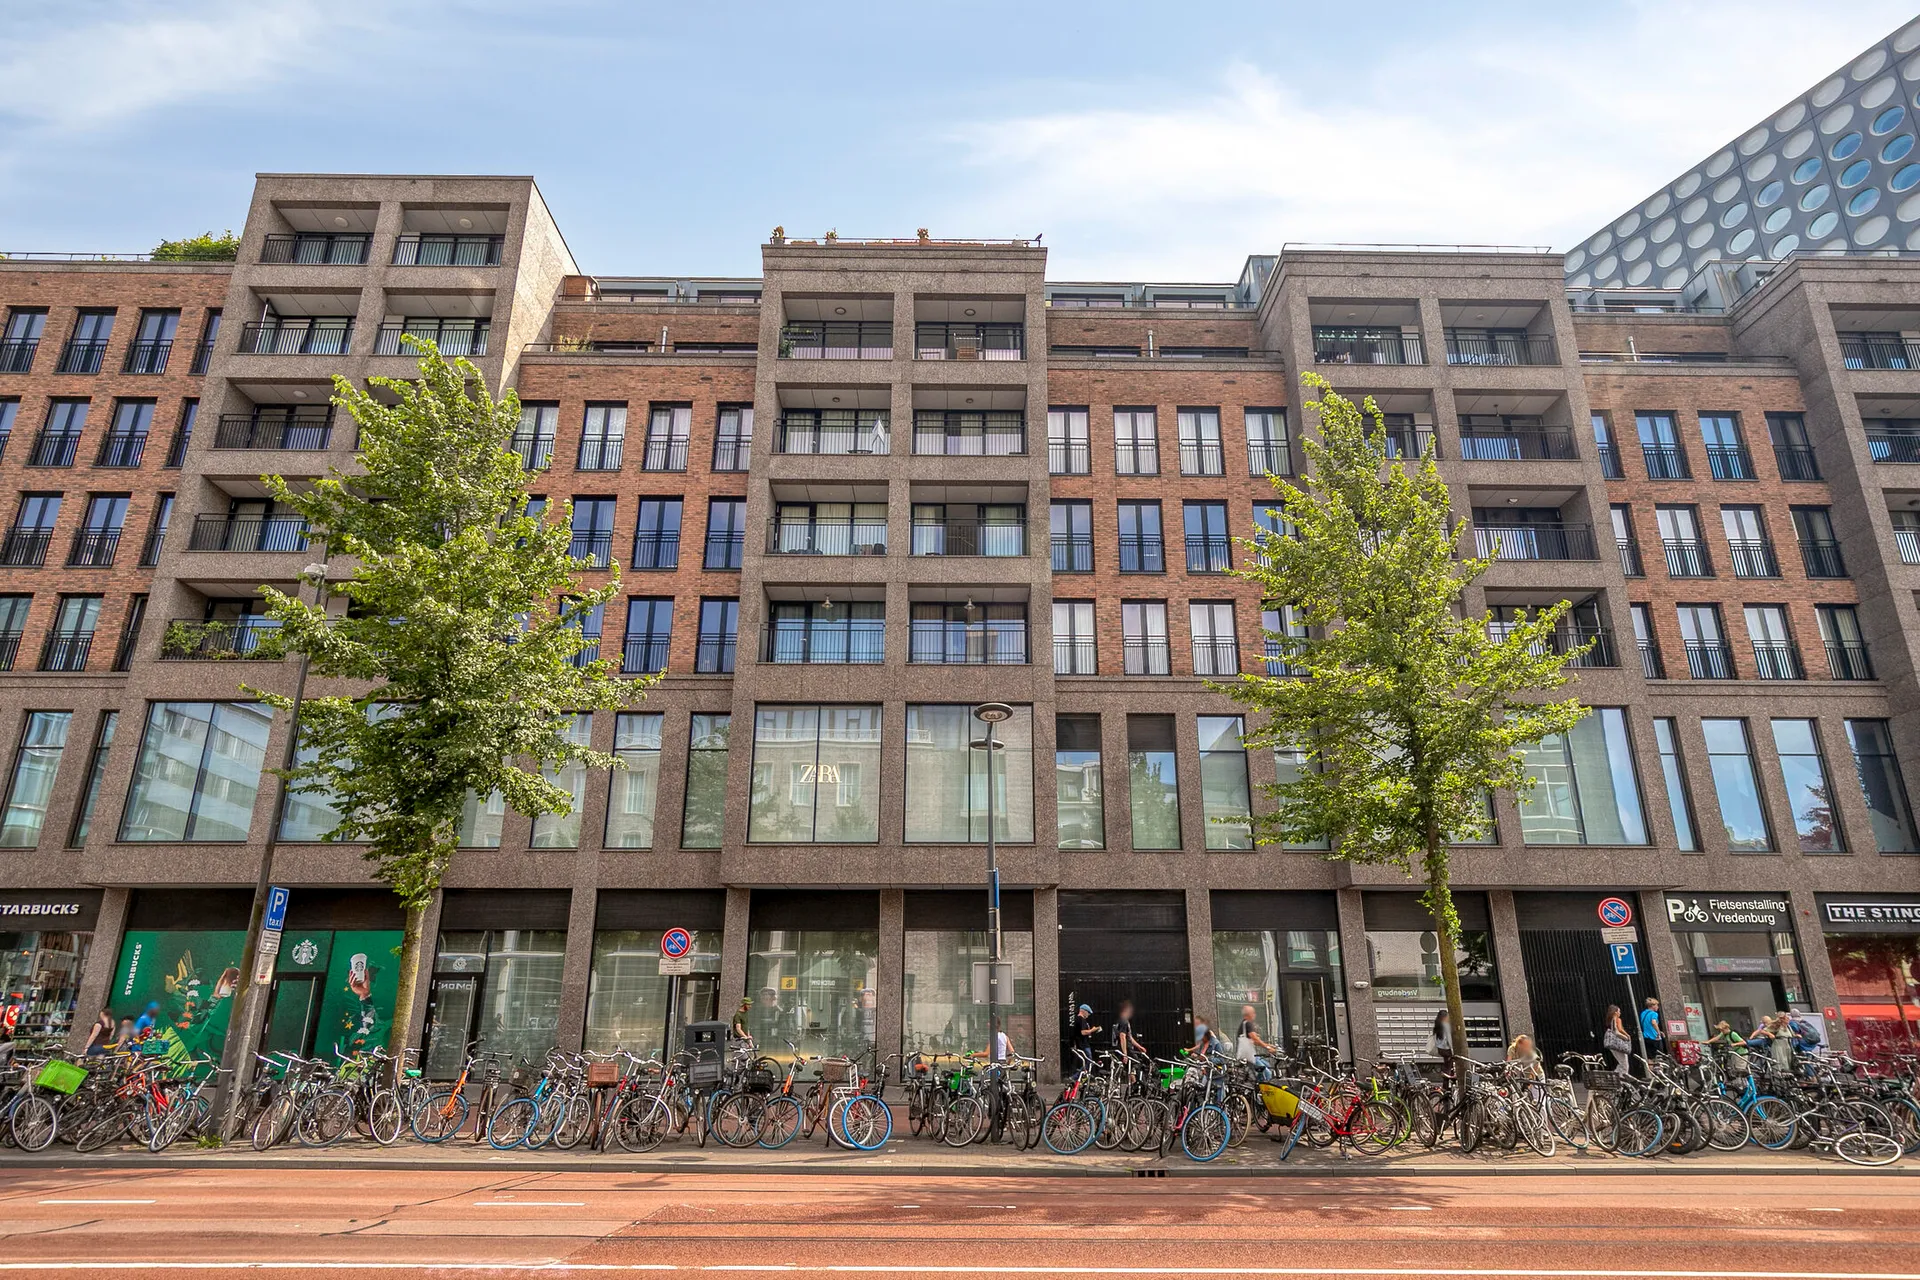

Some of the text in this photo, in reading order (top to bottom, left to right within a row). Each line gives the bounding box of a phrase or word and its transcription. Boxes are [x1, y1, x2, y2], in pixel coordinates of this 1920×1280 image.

[800, 764, 843, 783] ZARA
[272, 892, 284, 912] P
[1709, 899, 1786, 912] Fietsenstalling
[0, 904, 80, 915] TARBUCKS
[1666, 899, 1685, 922] P
[1831, 907, 1866, 918] THE
[268, 917, 282, 927] taxi
[1712, 912, 1776, 926] Vredenburg
[1616, 946, 1629, 961] P
[124, 942, 142, 996] STARBUCKS
